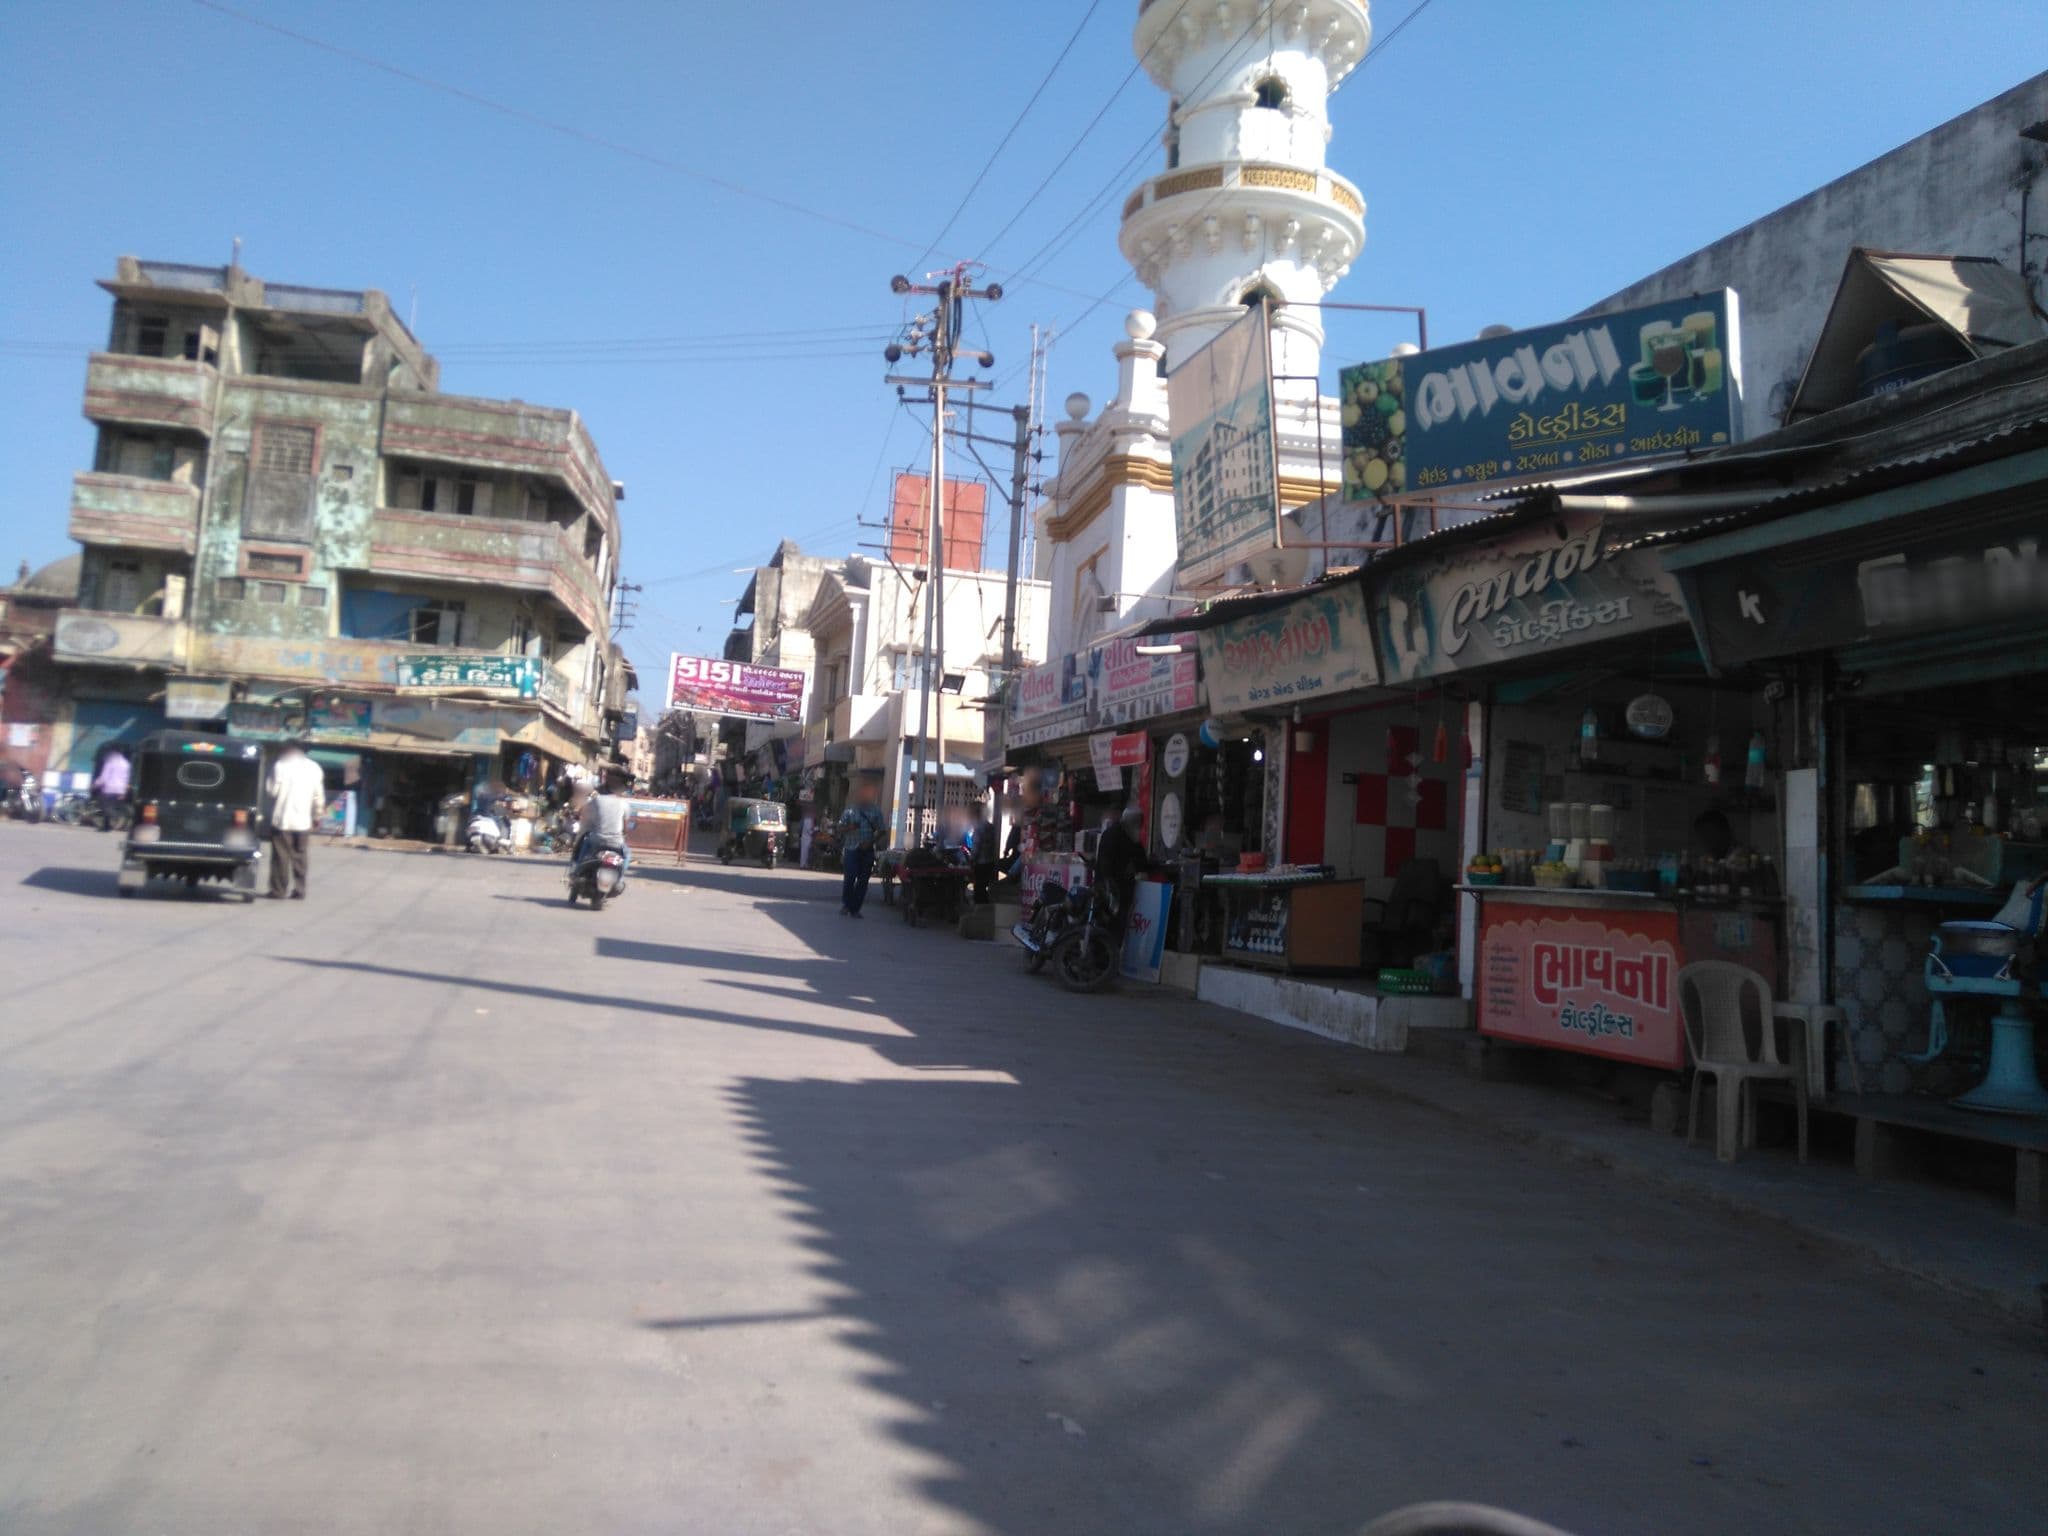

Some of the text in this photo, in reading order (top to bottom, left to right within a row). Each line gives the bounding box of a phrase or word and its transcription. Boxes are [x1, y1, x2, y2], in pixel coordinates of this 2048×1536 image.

[1415, 324, 1622, 432] ભાવના
[1578, 441, 1609, 461] સોડા
[677, 657, 742, 685] કાકા
[1532, 941, 1670, 1013] ભાવના
